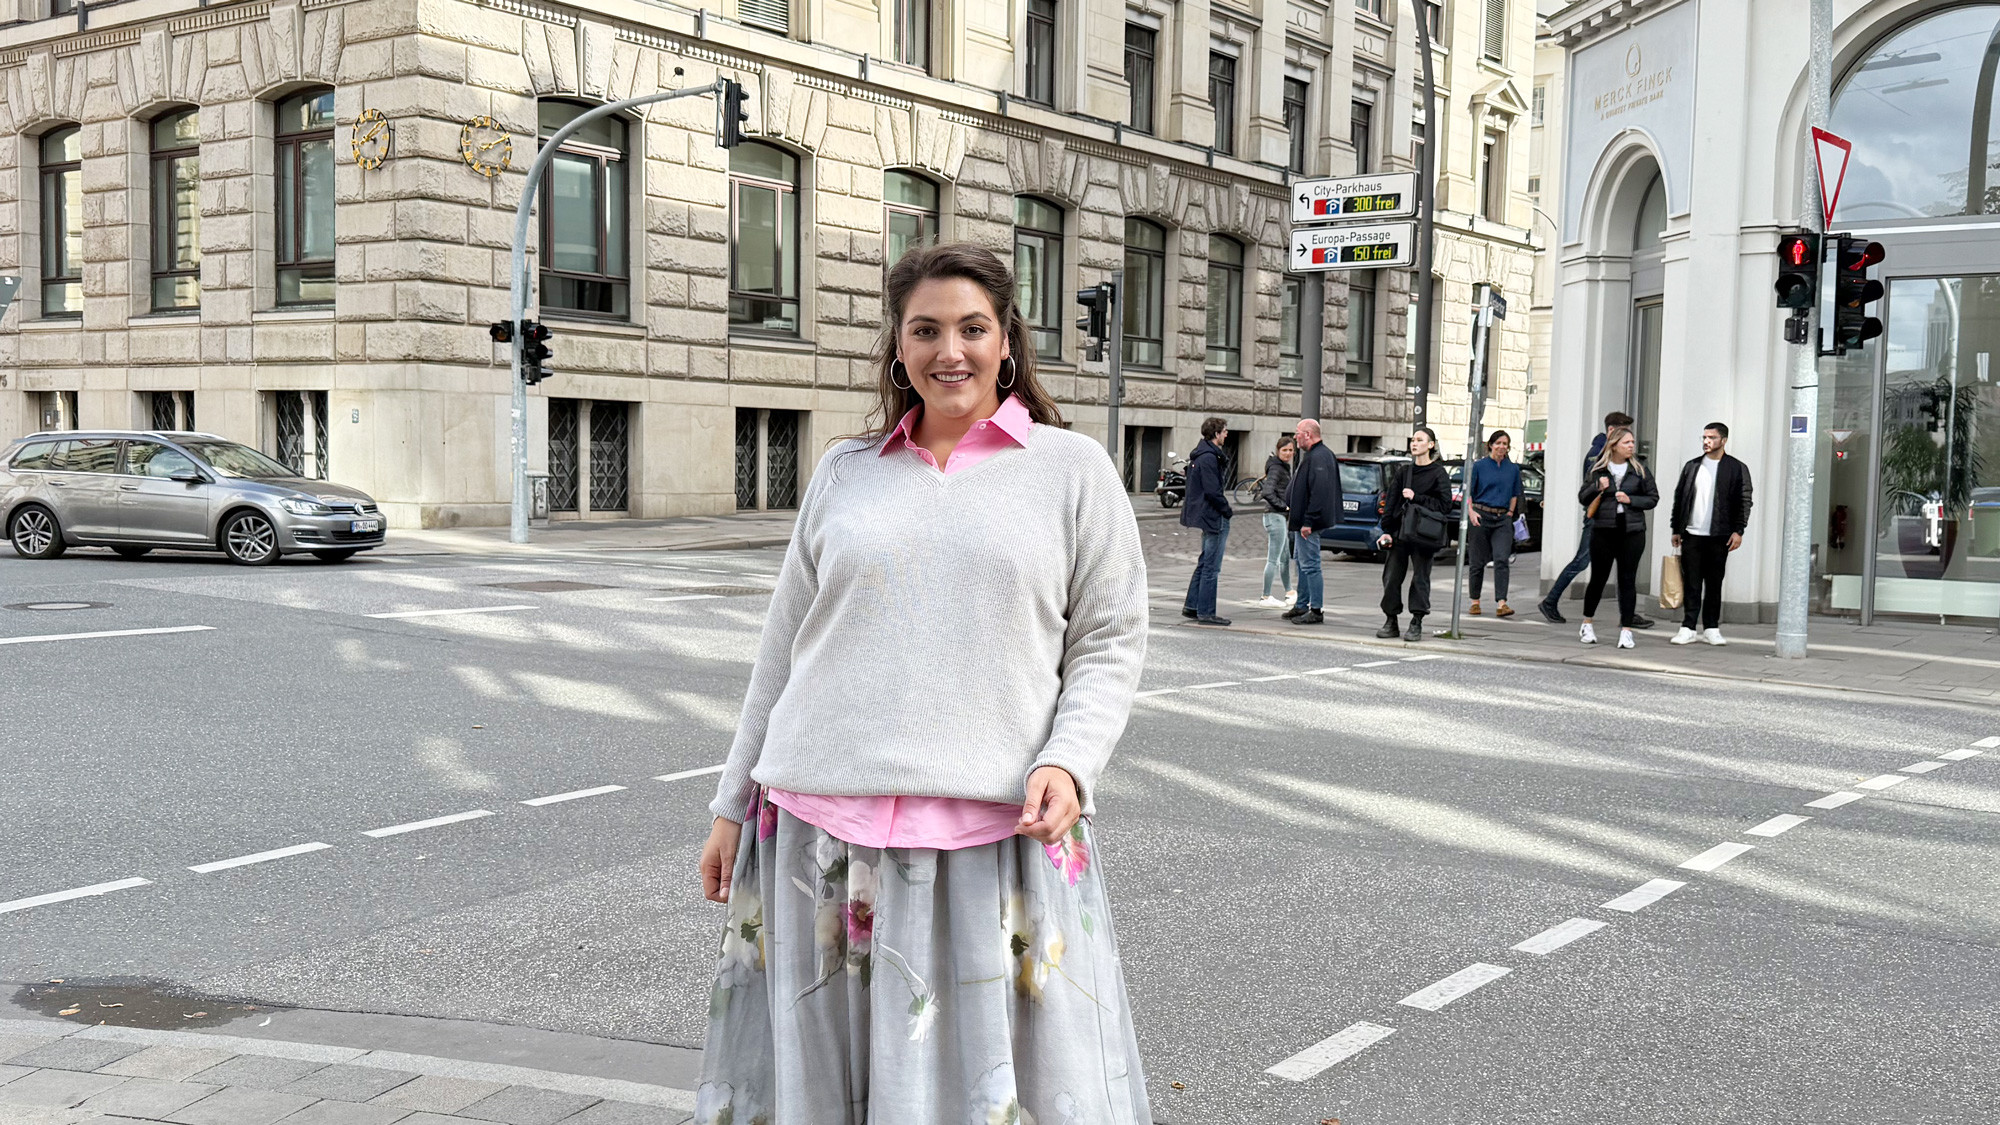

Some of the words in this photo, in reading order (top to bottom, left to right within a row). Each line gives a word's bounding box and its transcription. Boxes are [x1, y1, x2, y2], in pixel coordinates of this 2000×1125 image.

[1594, 83, 1632, 111] MERCK
[1637, 66, 1673, 94] FINCK
[1314, 183, 1382, 197] City-Parkhaus
[1353, 197, 1372, 212] 300
[1375, 195, 1395, 211] frei
[1312, 231, 1391, 245] Europa-Passage
[1352, 245, 1370, 261] 150
[1373, 244, 1392, 260] frei
